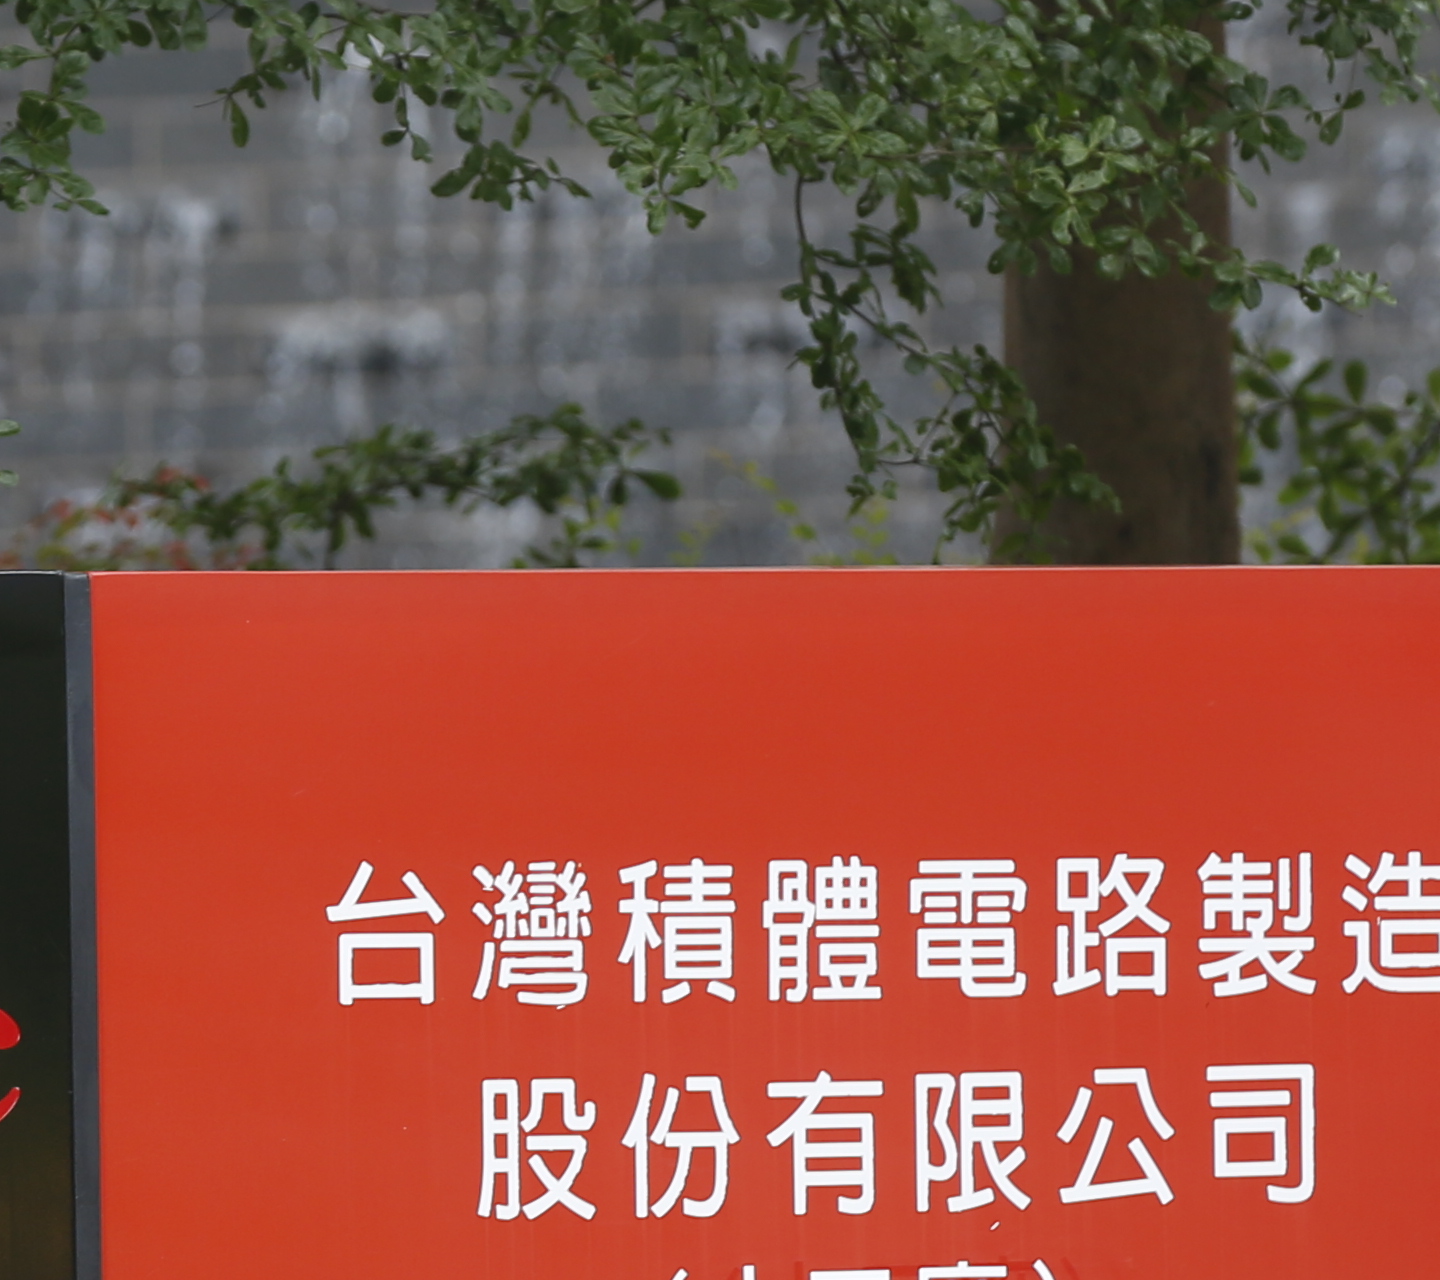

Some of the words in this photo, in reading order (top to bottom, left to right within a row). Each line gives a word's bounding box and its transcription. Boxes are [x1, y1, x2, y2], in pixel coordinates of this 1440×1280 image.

[477, 1062, 1317, 1221] 股份有限公司
